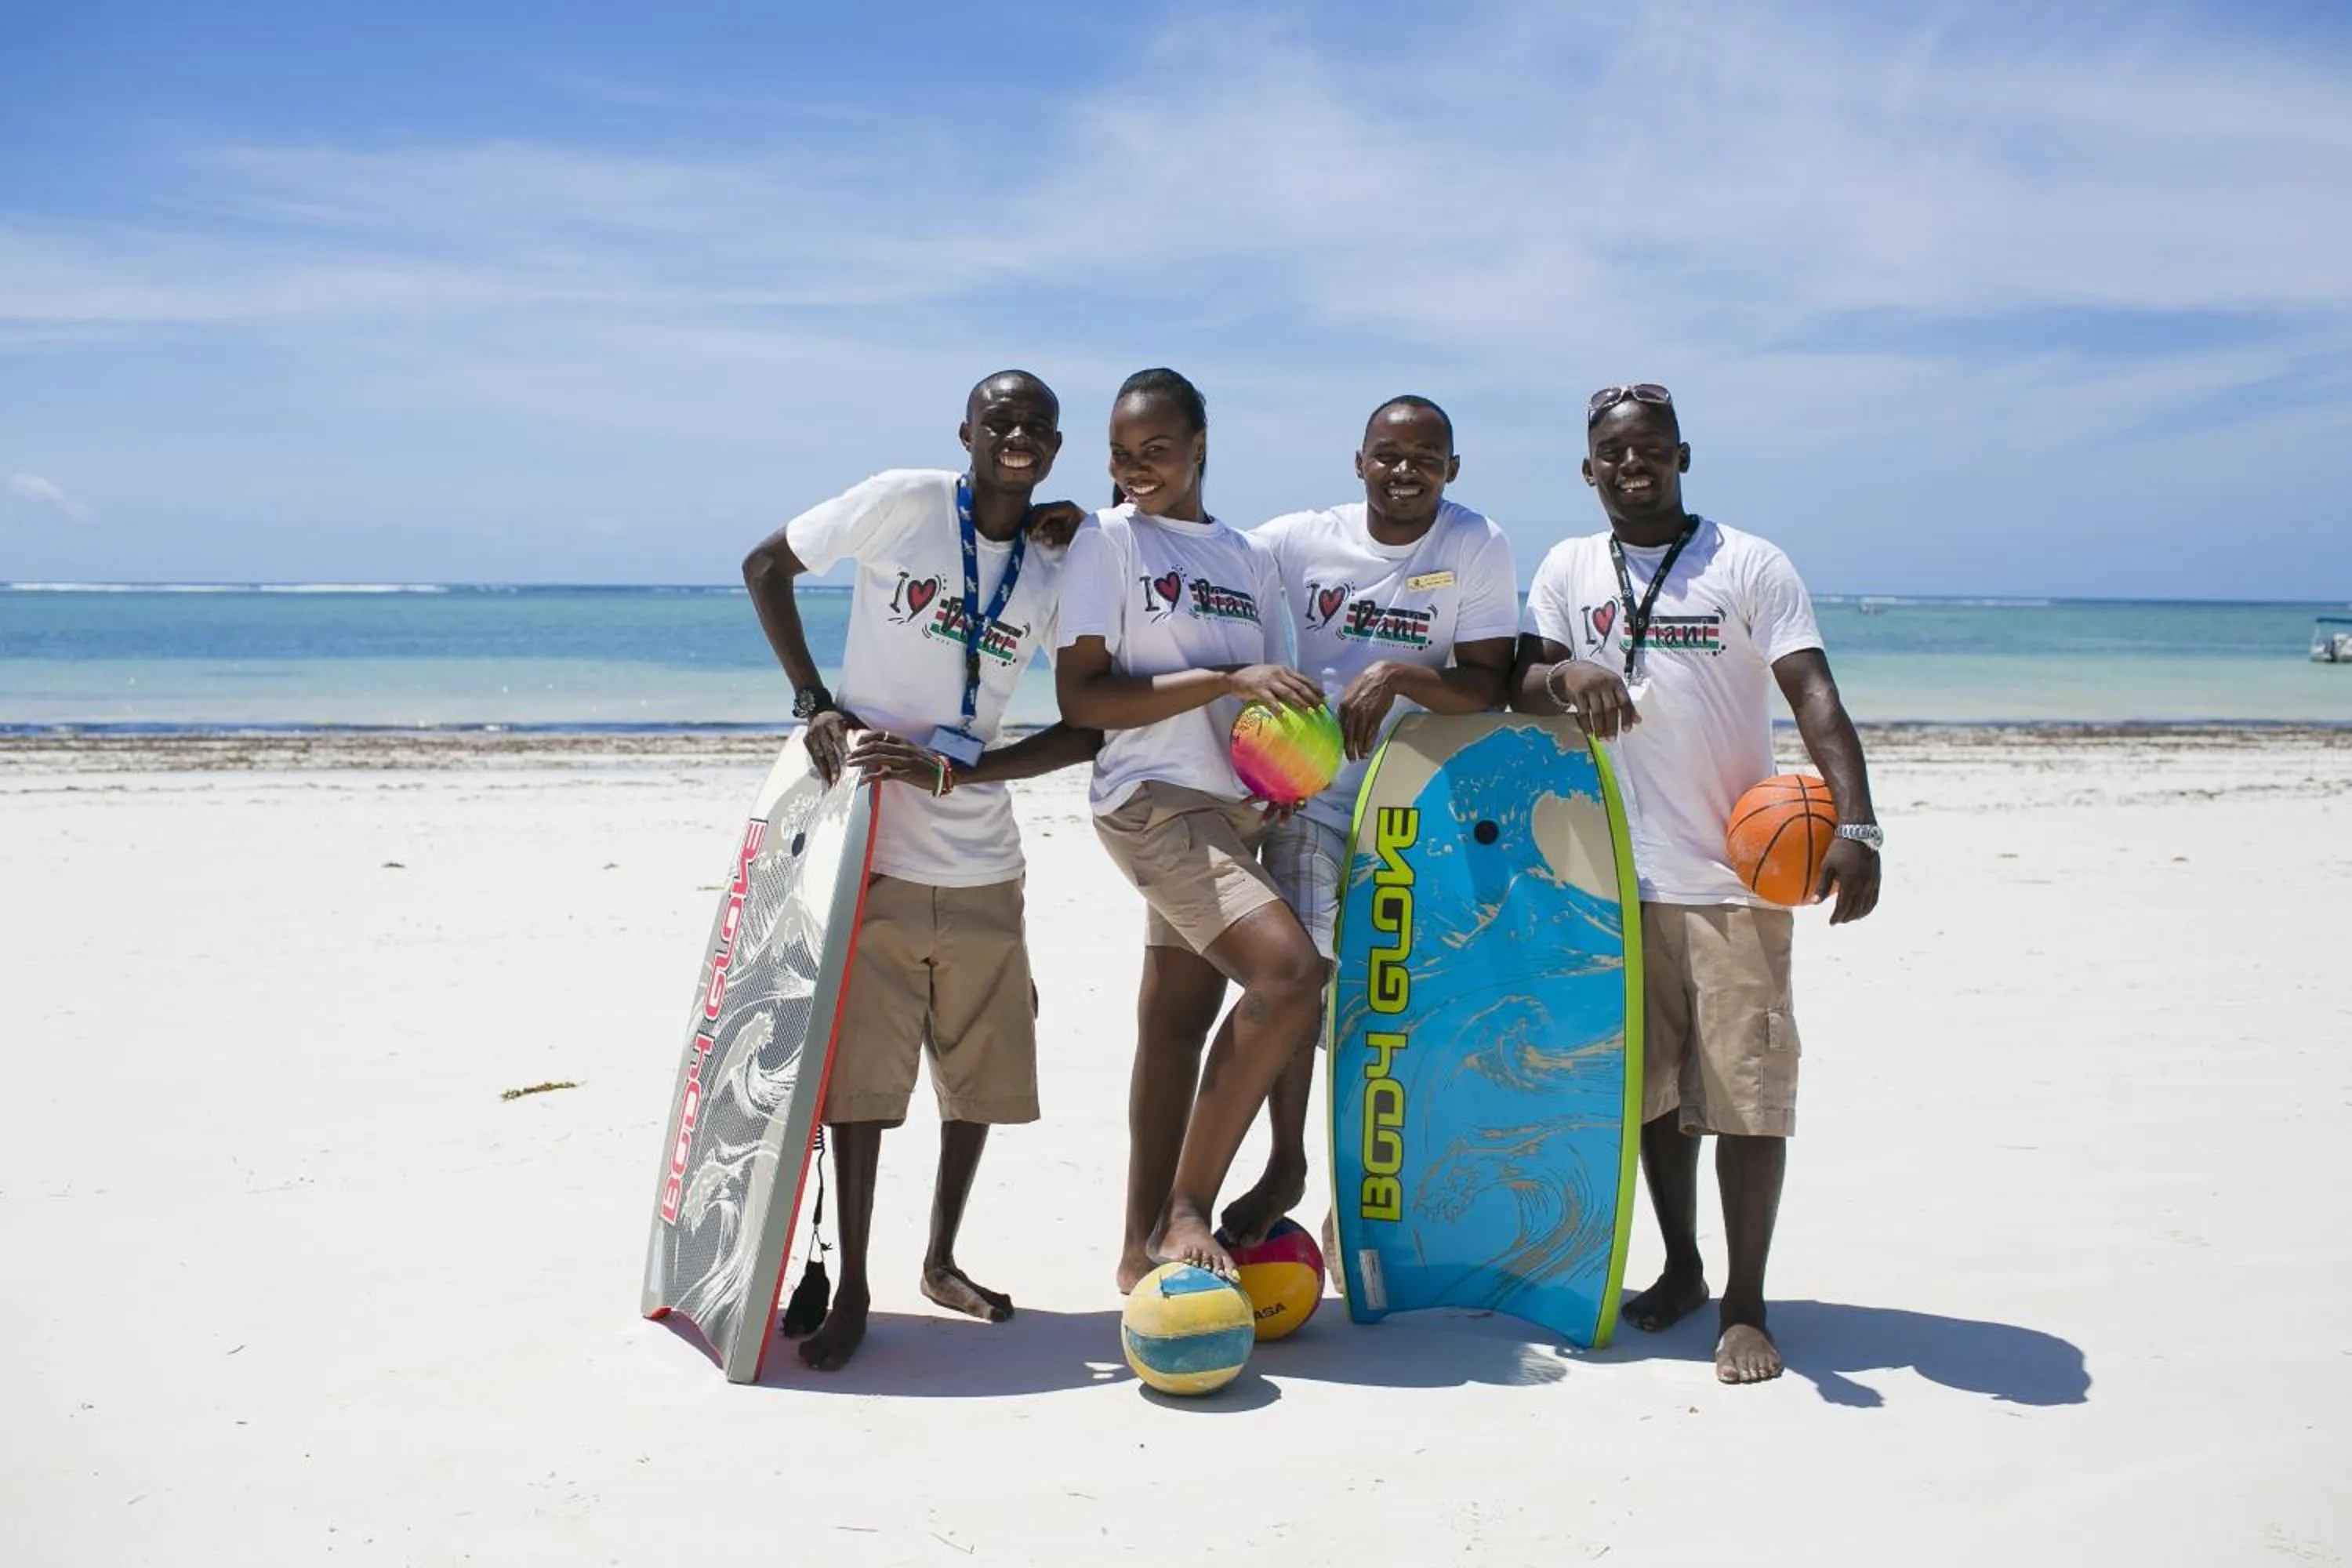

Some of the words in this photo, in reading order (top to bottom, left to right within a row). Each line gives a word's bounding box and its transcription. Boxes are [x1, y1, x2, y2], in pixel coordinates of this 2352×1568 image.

[890, 572, 909, 614] I
[1139, 575, 1160, 612] I
[1305, 583, 1321, 622] I
[1581, 605, 1597, 645] I
[1632, 616, 1709, 646] iani
[1367, 806, 1421, 1016] GLOVE
[659, 1030, 715, 1225] BODY
[703, 818, 769, 1022] GLOVE
[1361, 1032, 1409, 1223] BODY
[1254, 1301, 1287, 1321] ASA
